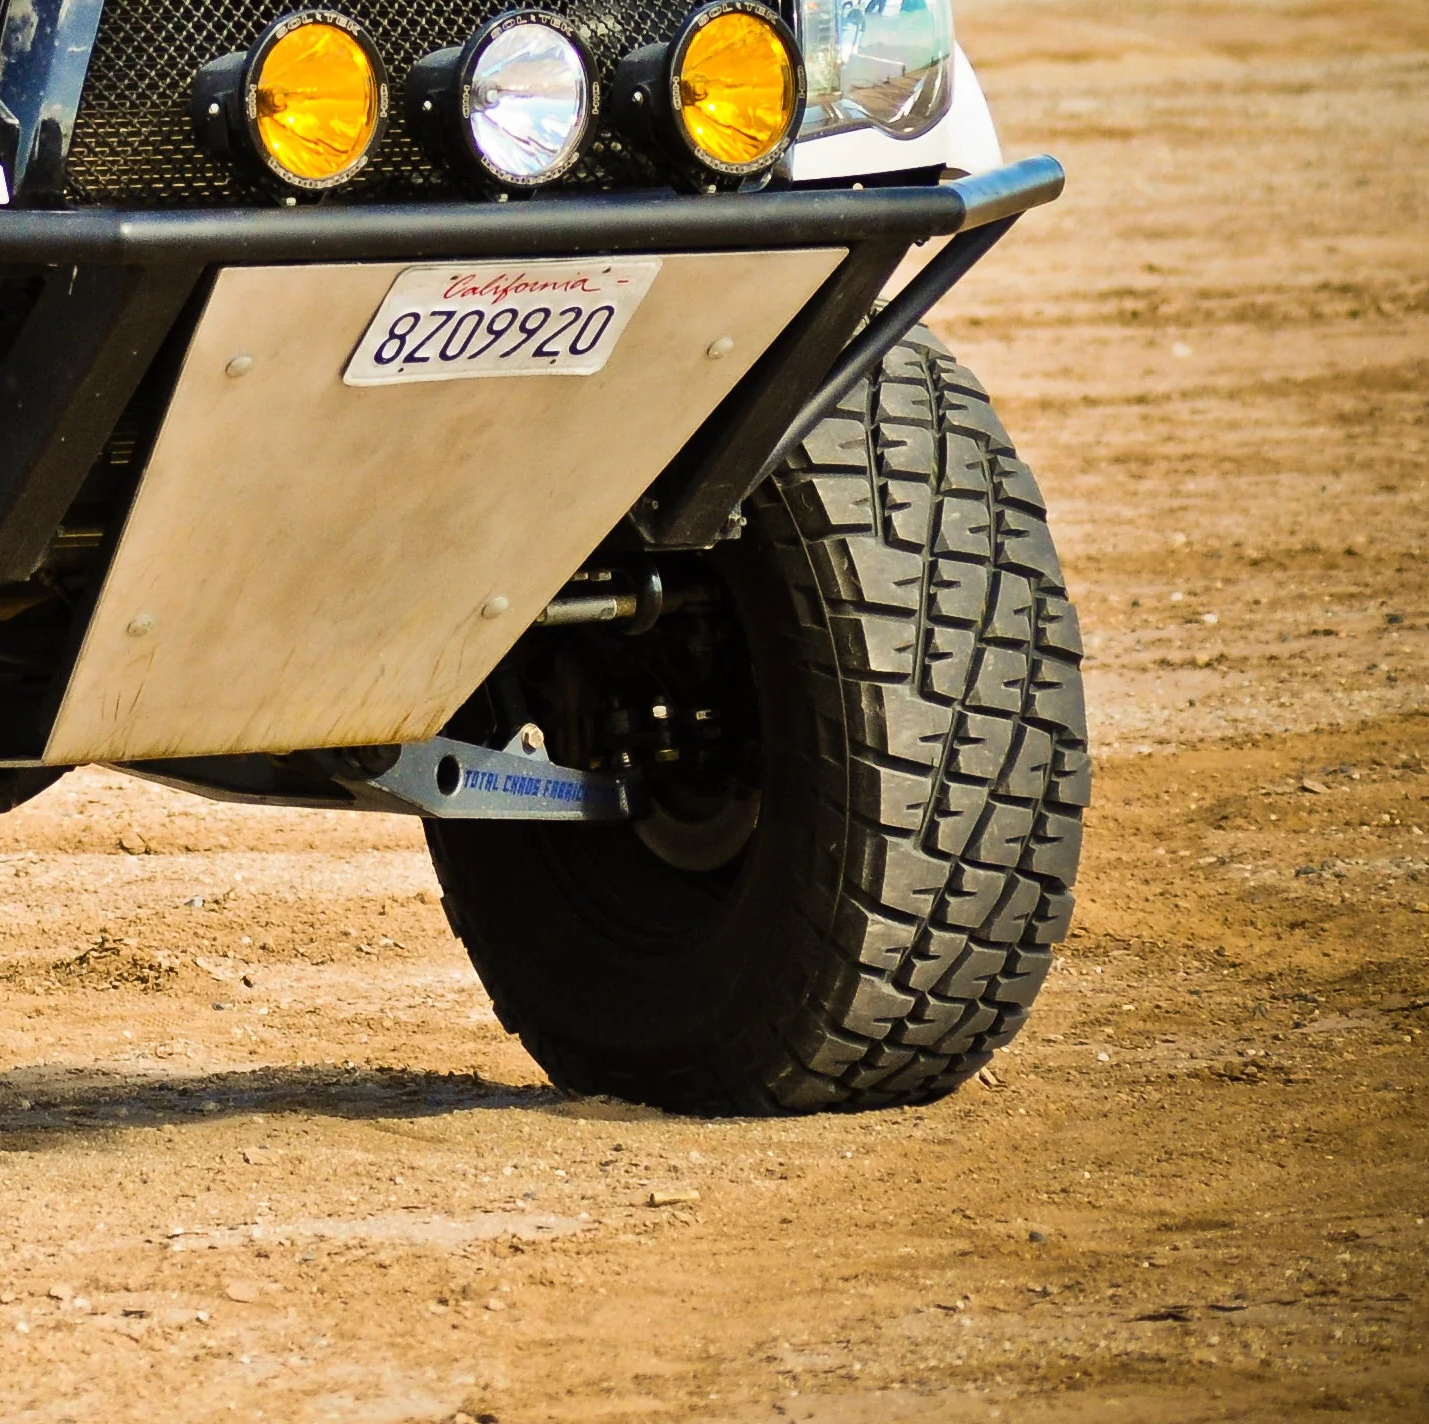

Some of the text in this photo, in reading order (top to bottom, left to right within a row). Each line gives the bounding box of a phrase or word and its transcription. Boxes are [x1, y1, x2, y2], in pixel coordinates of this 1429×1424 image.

[443, 272, 603, 306] California
[372, 304, 616, 366] 8Z09920
[464, 769, 499, 793] TOTAL
[503, 773, 541, 797] CHAOS
